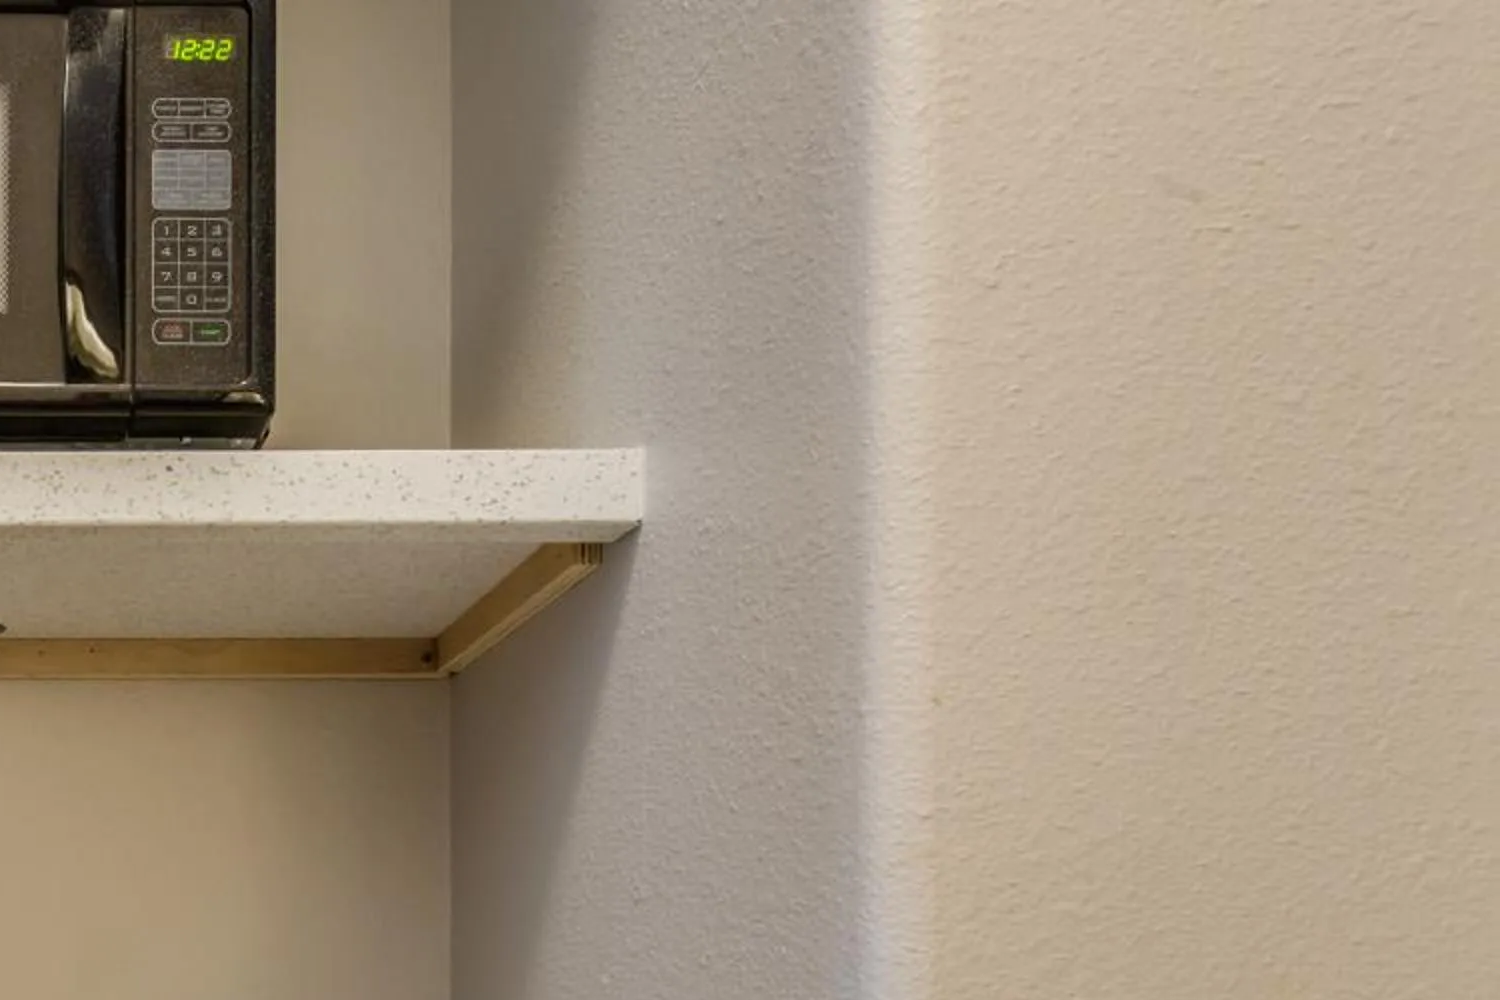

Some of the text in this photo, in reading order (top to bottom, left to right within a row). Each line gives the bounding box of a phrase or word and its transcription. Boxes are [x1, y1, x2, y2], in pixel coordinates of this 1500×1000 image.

[173, 38, 233, 61] 12:22
[187, 225, 198, 237] 2
[161, 246, 223, 257] 4 5 6
[160, 271, 172, 283] 7
[211, 271, 223, 283] 9
[185, 294, 198, 306] 0
